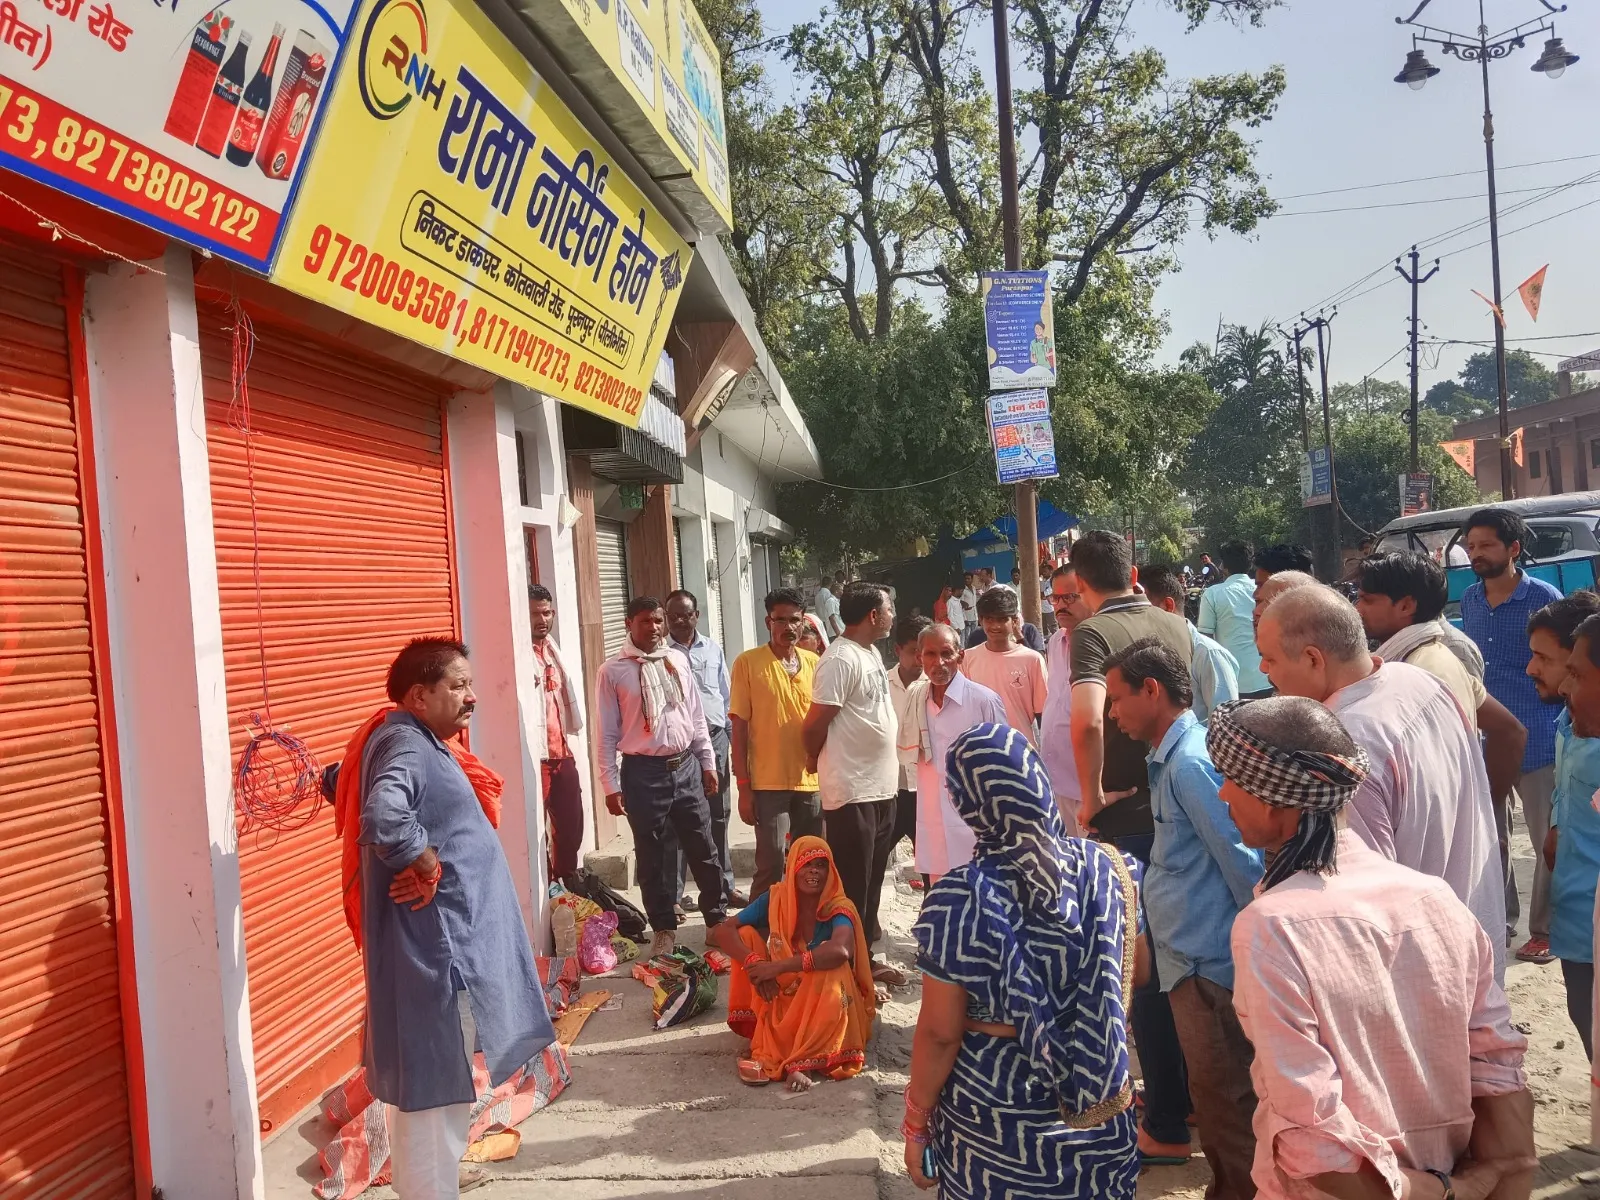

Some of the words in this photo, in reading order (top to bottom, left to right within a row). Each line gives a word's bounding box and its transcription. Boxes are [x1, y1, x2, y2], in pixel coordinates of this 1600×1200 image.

[87, 2, 134, 53] रोड
[381, 33, 447, 112] RNH
[437, 64, 537, 218] रामा
[608, 207, 659, 316] होम
[413, 199, 459, 253] निकट
[455, 233, 502, 283] डाकघर,
[503, 262, 550, 308] कोतवाली
[547, 287, 565, 322] रोड,
[565, 304, 597, 344] पूरनपुर
[592, 316, 631, 364] (पीलीभीत)
[573, 360, 643, 417] 8273802122
